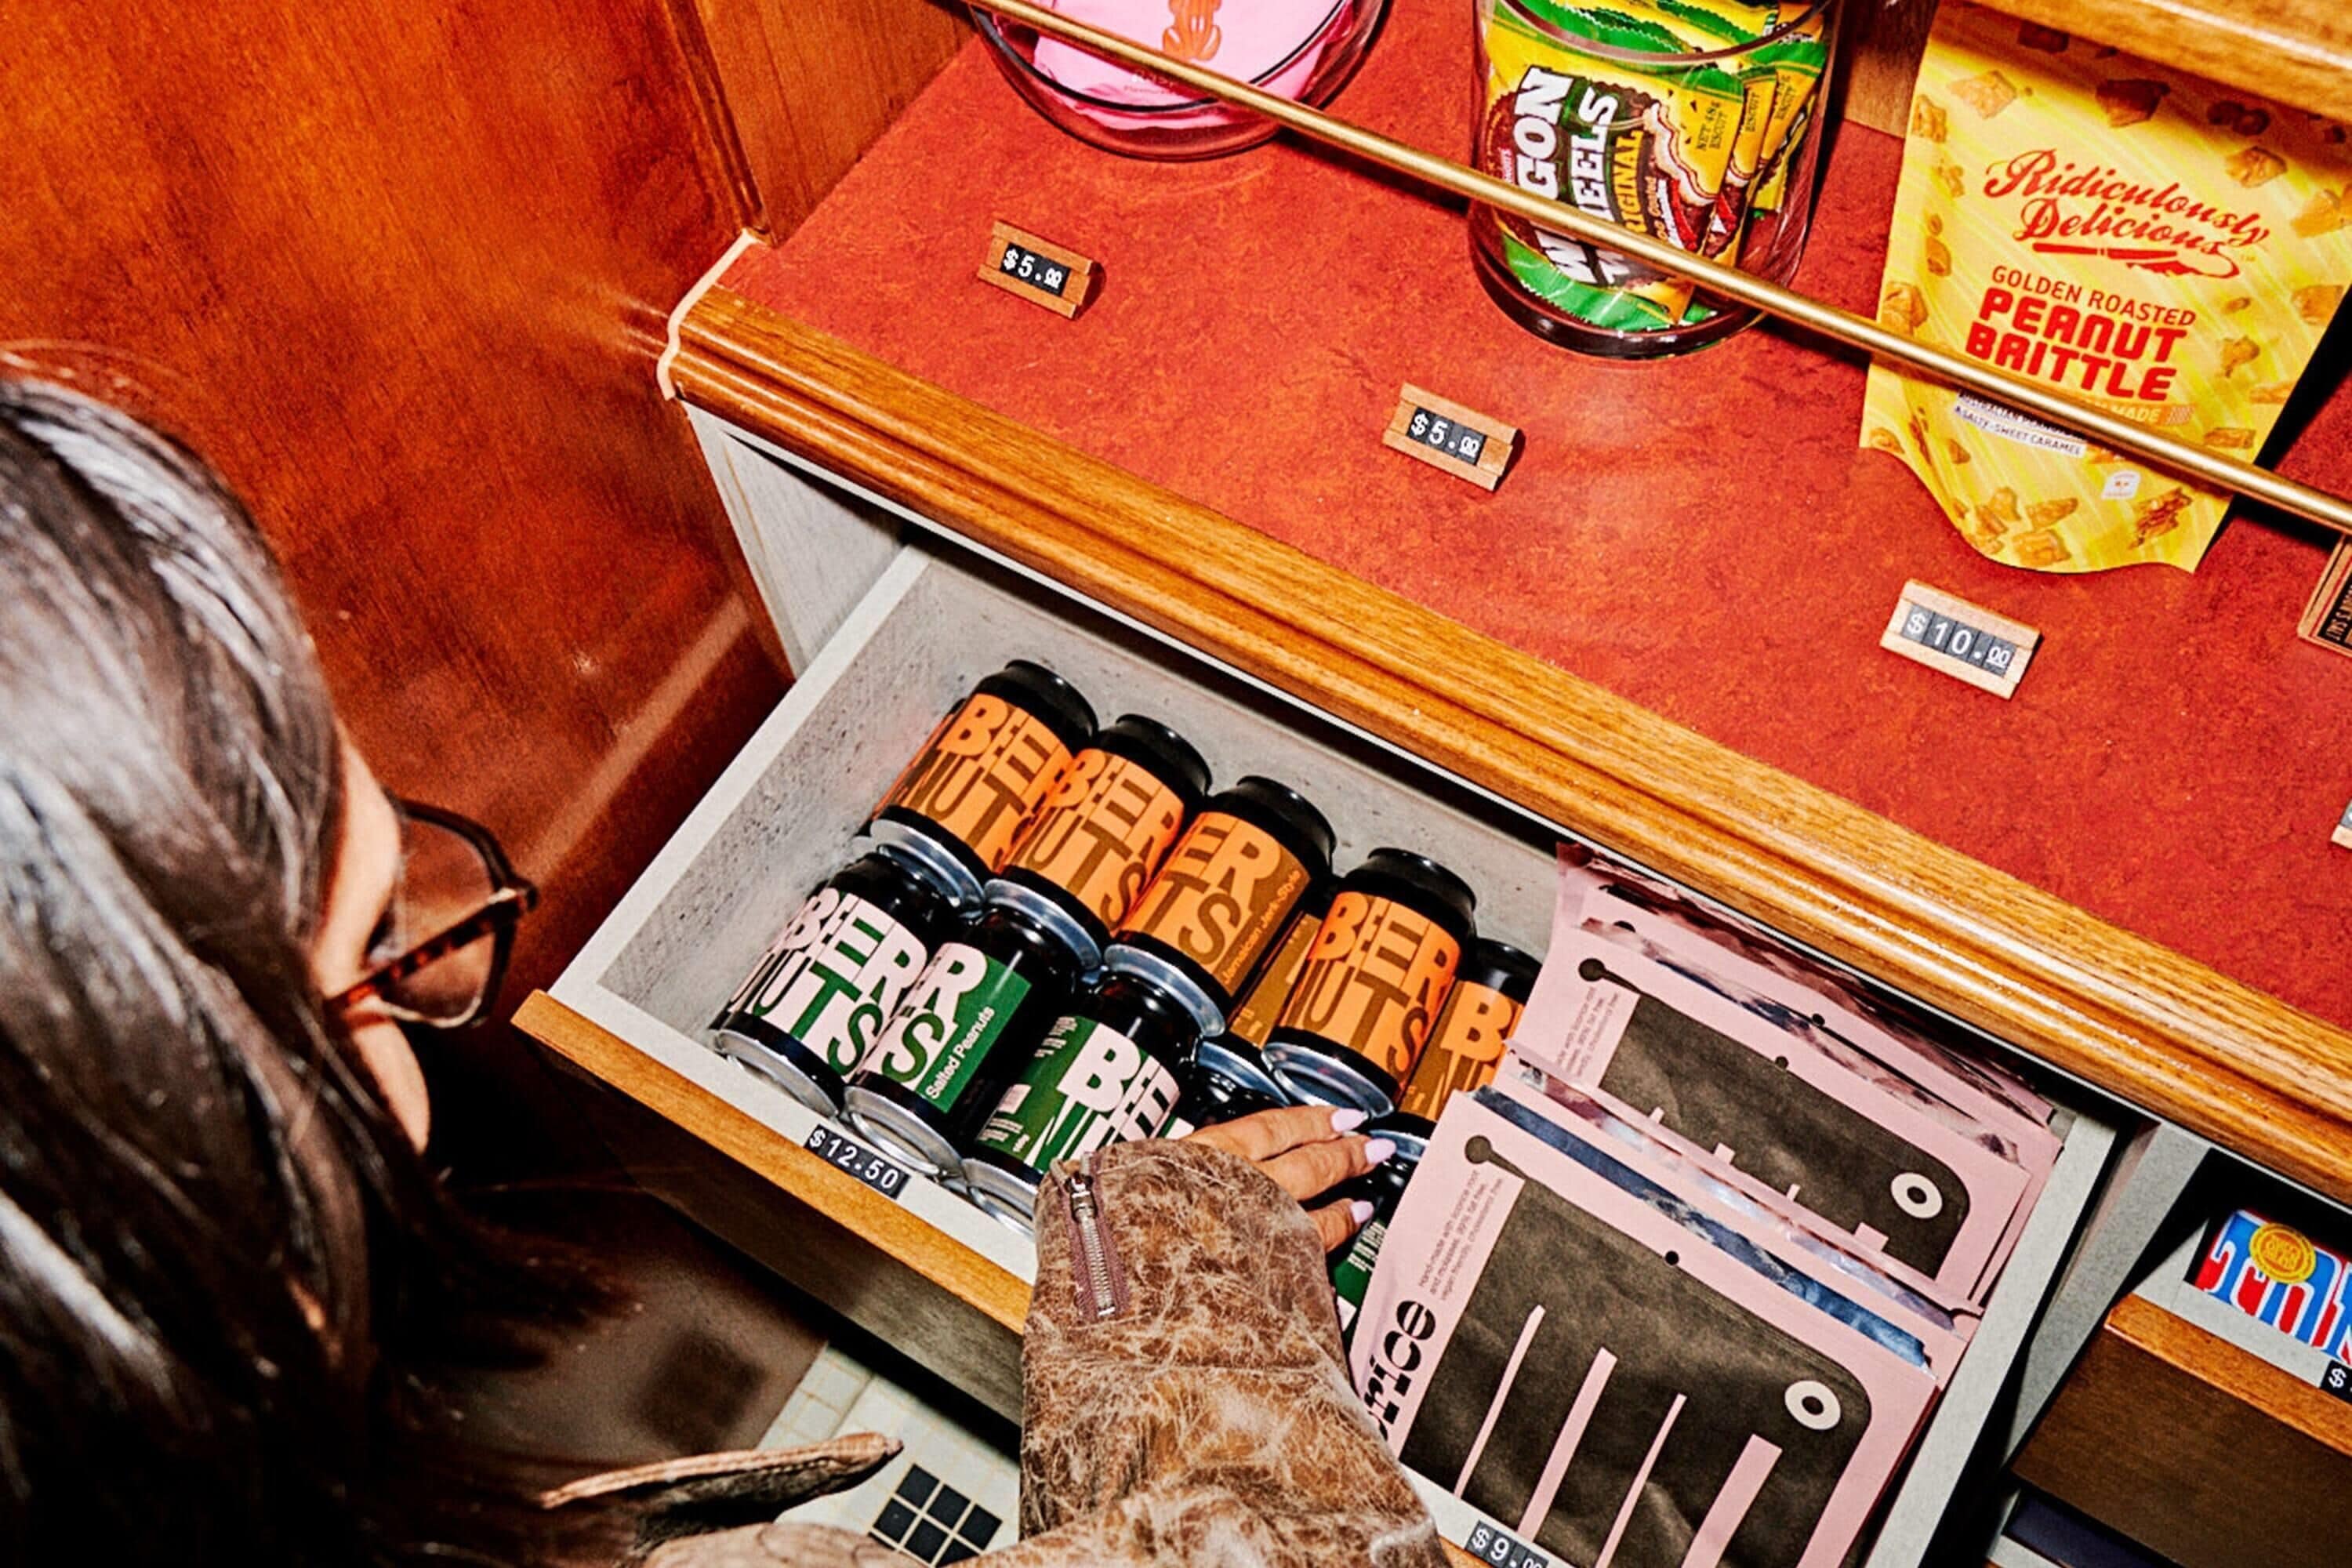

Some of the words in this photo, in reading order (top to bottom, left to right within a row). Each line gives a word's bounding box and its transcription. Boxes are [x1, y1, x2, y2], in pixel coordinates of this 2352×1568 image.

[1512, 67, 1599, 283] WGON
[1613, 130, 1647, 233] RIGINAL
[1984, 148, 2270, 247] Ridiculously
[2013, 198, 2230, 256] Delicious
[1003, 249, 1062, 289] $5.00
[1991, 265, 2082, 303] GOLDEN
[2088, 289, 2197, 326] ROASTED
[1965, 321, 2177, 401] BRITTLE
[1979, 287, 2187, 363] PEANUT
[1410, 412, 1481, 459] $5.00
[2029, 433, 2083, 456] CARAMEL
[1907, 612, 2011, 669] $10.00
[1045, 748, 1185, 870] BEER
[782, 887, 928, 1018] BEER
[1222, 927, 1262, 985] Jamaican
[1309, 891, 1461, 1013] BEER
[925, 1055, 961, 1099] Salted
[953, 1006, 996, 1059] Peanuts
[809, 1129, 900, 1189] $12.50
